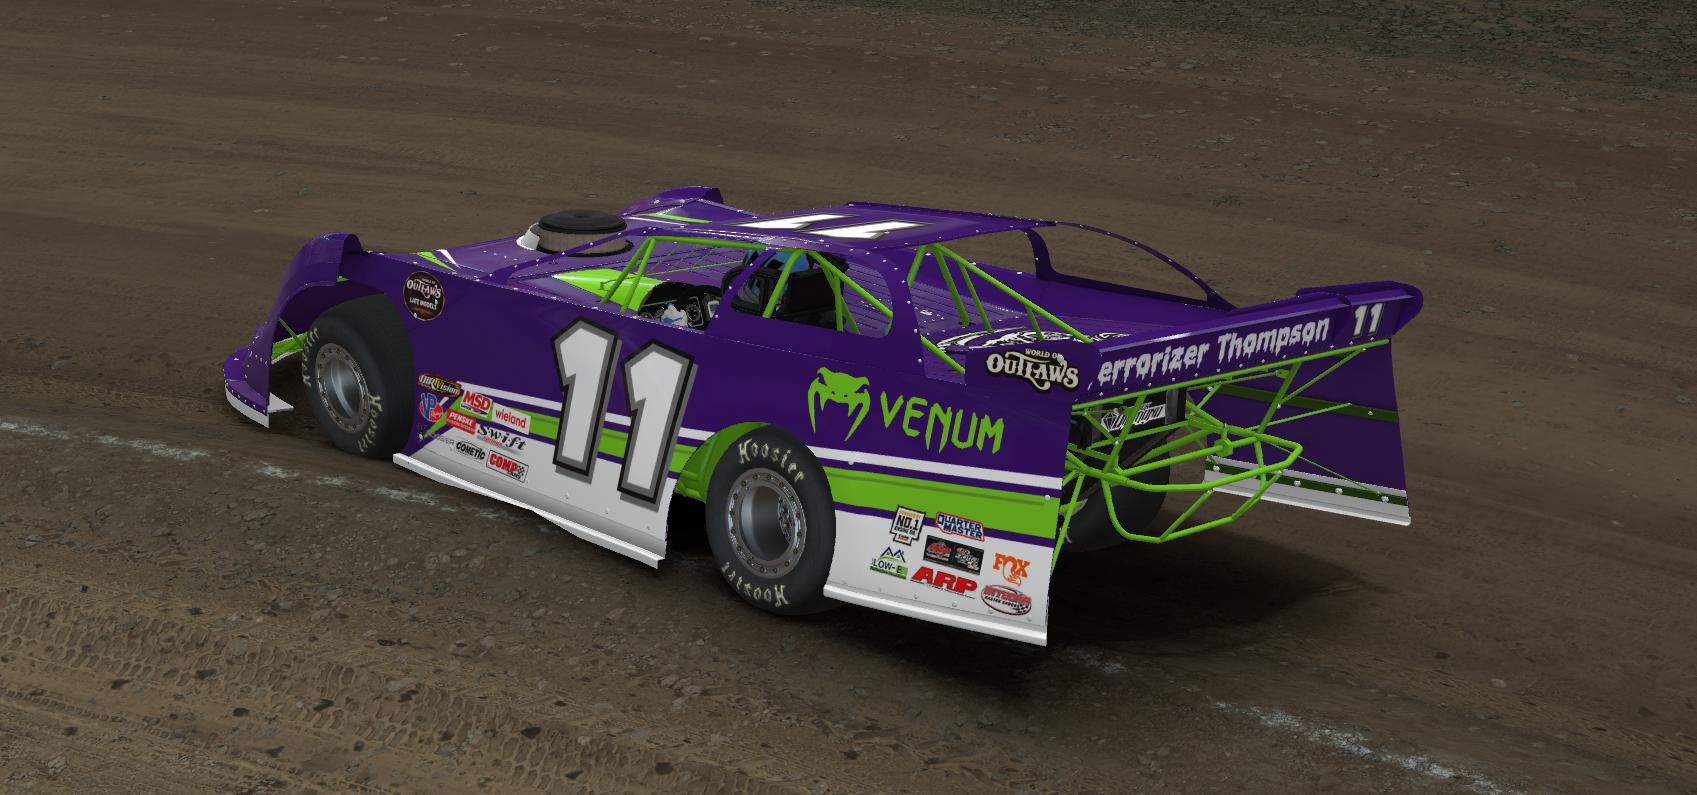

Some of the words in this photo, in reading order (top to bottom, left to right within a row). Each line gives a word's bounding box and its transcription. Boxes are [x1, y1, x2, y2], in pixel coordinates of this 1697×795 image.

[1353, 302, 1385, 337] 11
[1025, 348, 1050, 359] WORLD
[1087, 342, 1209, 391] errorizer
[1216, 316, 1330, 364] Thompson
[986, 351, 1079, 391] OUTLAWS
[463, 389, 491, 411] MSD
[495, 408, 527, 429] wieland
[553, 316, 699, 513] 11
[880, 390, 1005, 455] VENUM
[477, 425, 527, 450] Swift
[489, 453, 519, 473] COMP
[738, 438, 805, 483] Hoosier
[937, 514, 982, 531] QUARTER
[943, 523, 983, 539] MASTER
[911, 566, 978, 594] ARP
[993, 553, 1031, 580] FOX
[721, 561, 789, 608] Hoosier
